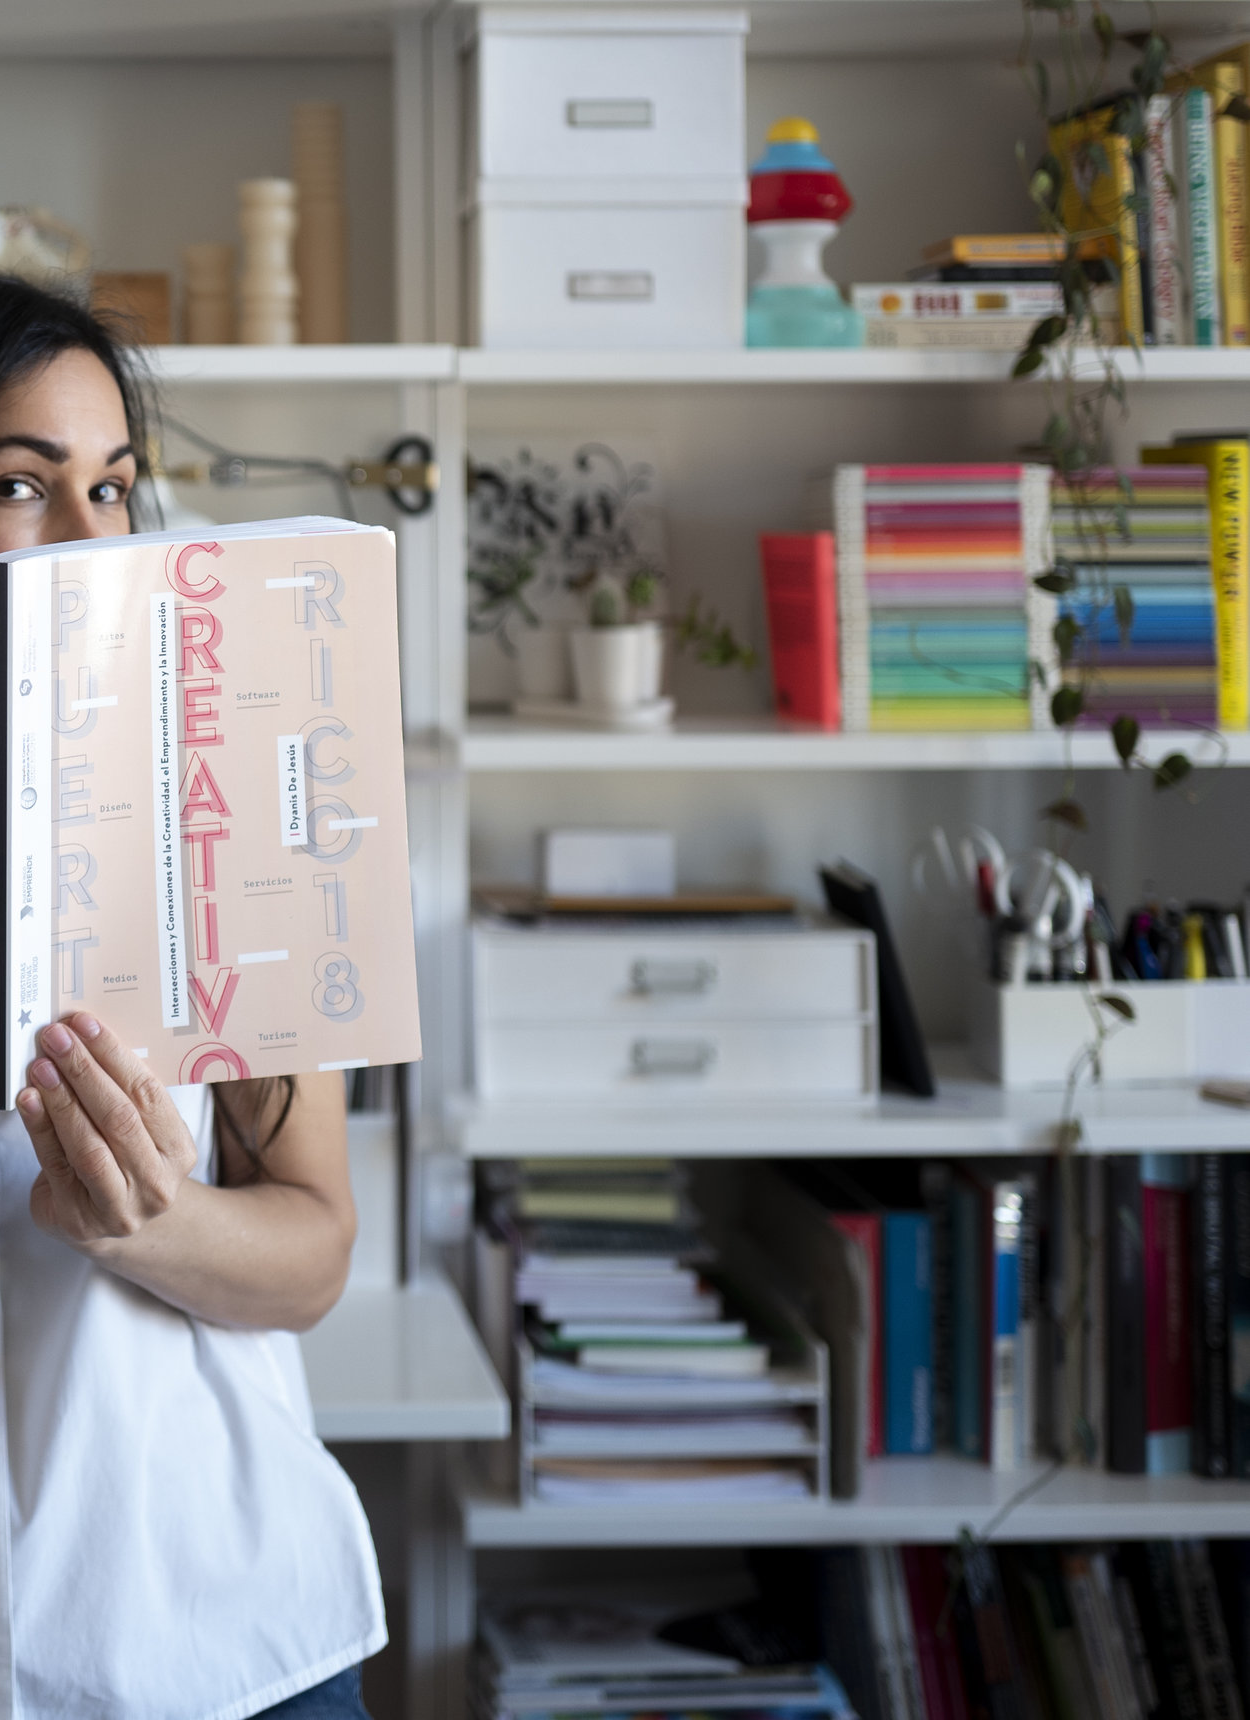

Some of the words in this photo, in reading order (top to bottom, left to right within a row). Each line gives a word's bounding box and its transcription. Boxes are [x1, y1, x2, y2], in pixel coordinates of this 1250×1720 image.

[157, 601, 166, 656] Innovación
[158, 659, 166, 668] la
[236, 690, 280, 701] Software
[159, 679, 170, 764] Emprendimiento
[286, 744, 296, 773] Jesús
[160, 766, 169, 776] el
[51, 579, 102, 1001] PUERT
[288, 777, 297, 791] De
[100, 802, 132, 813] Diseño
[160, 778, 171, 841] Creatividad,
[165, 541, 251, 1085] CREATIVO
[290, 794, 301, 829] Dyanis
[163, 844, 171, 854] la
[163, 855, 172, 868] de
[244, 876, 293, 888] Servicios
[165, 870, 174, 931] Conexiones
[170, 933, 178, 941] y
[103, 973, 138, 984] Medios
[168, 943, 179, 1018] Intersecciones
[258, 1030, 297, 1041] Turismo
